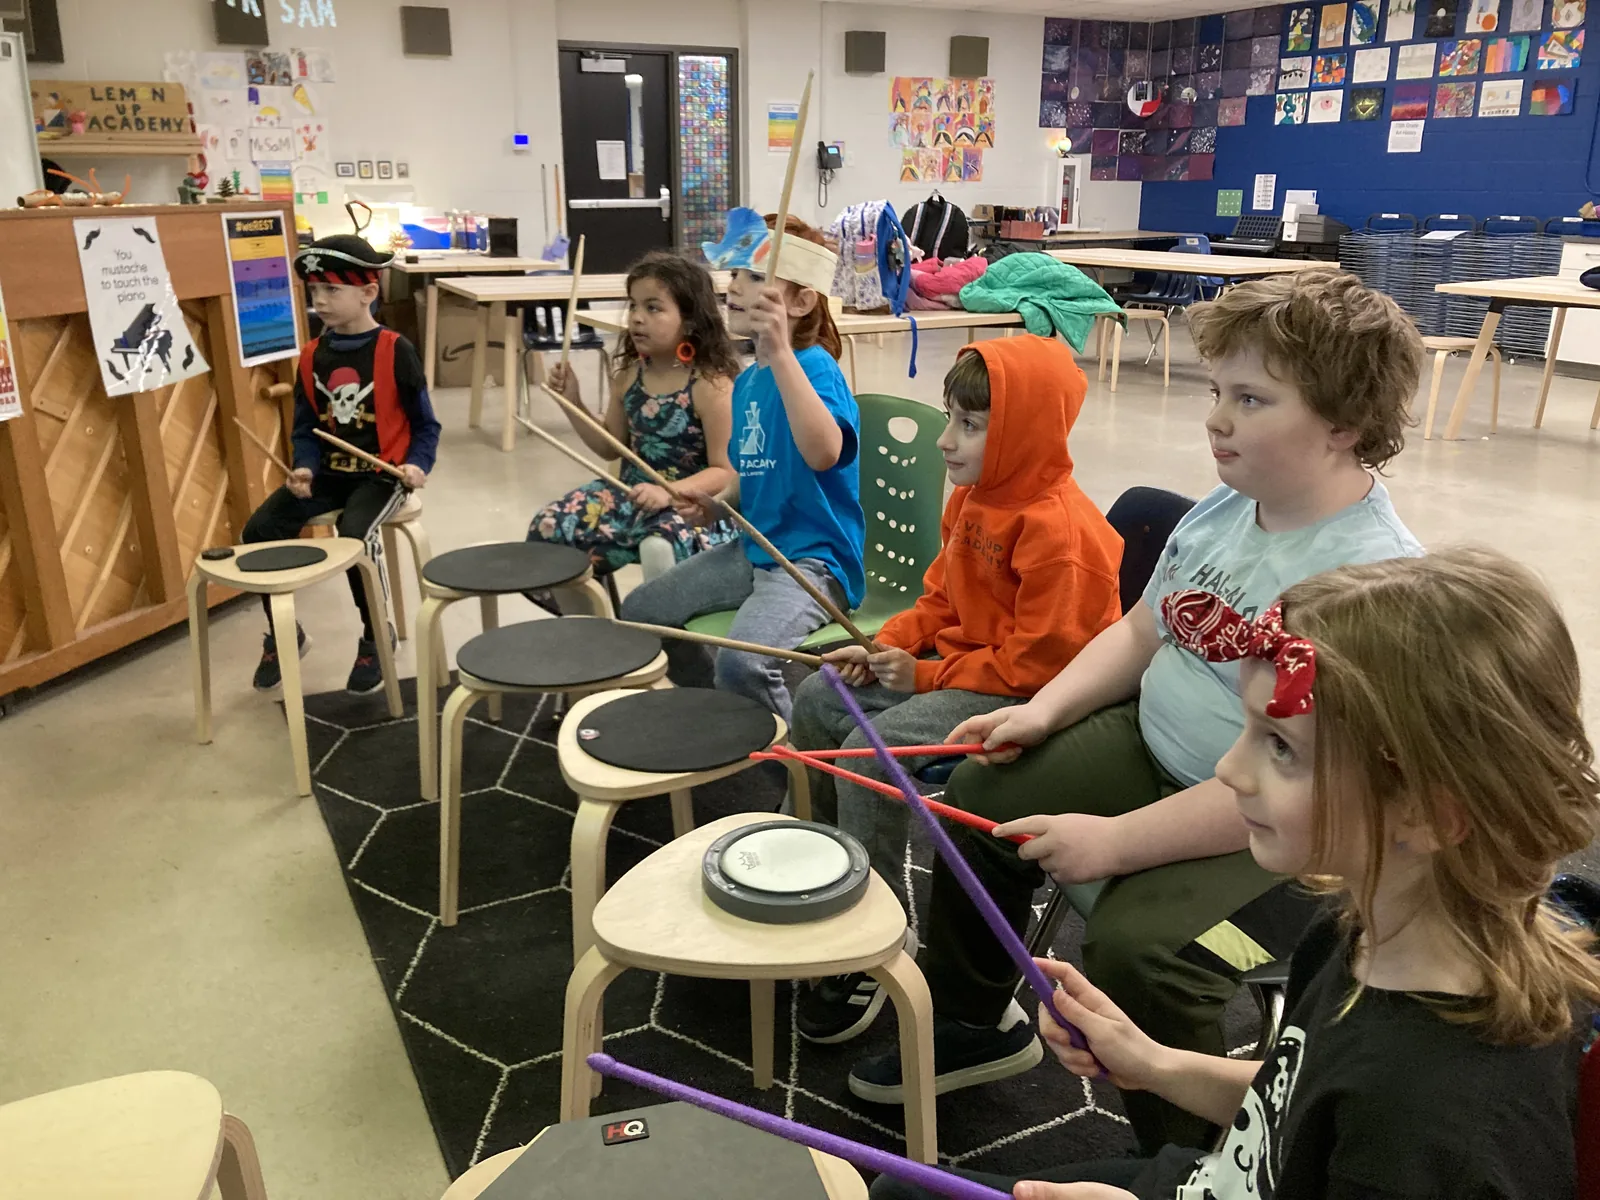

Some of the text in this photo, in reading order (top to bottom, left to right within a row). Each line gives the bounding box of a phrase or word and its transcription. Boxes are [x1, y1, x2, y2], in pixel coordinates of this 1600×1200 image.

[280, 0, 337, 28] SAM
[115, 103, 141, 116] UP
[88, 115, 184, 132] ACADEMY
[113, 249, 132, 260] You
[101, 262, 148, 276] mustache
[101, 275, 159, 290] to touch the
[117, 291, 146, 305] piano
[606, 1120, 646, 1139] HQ
